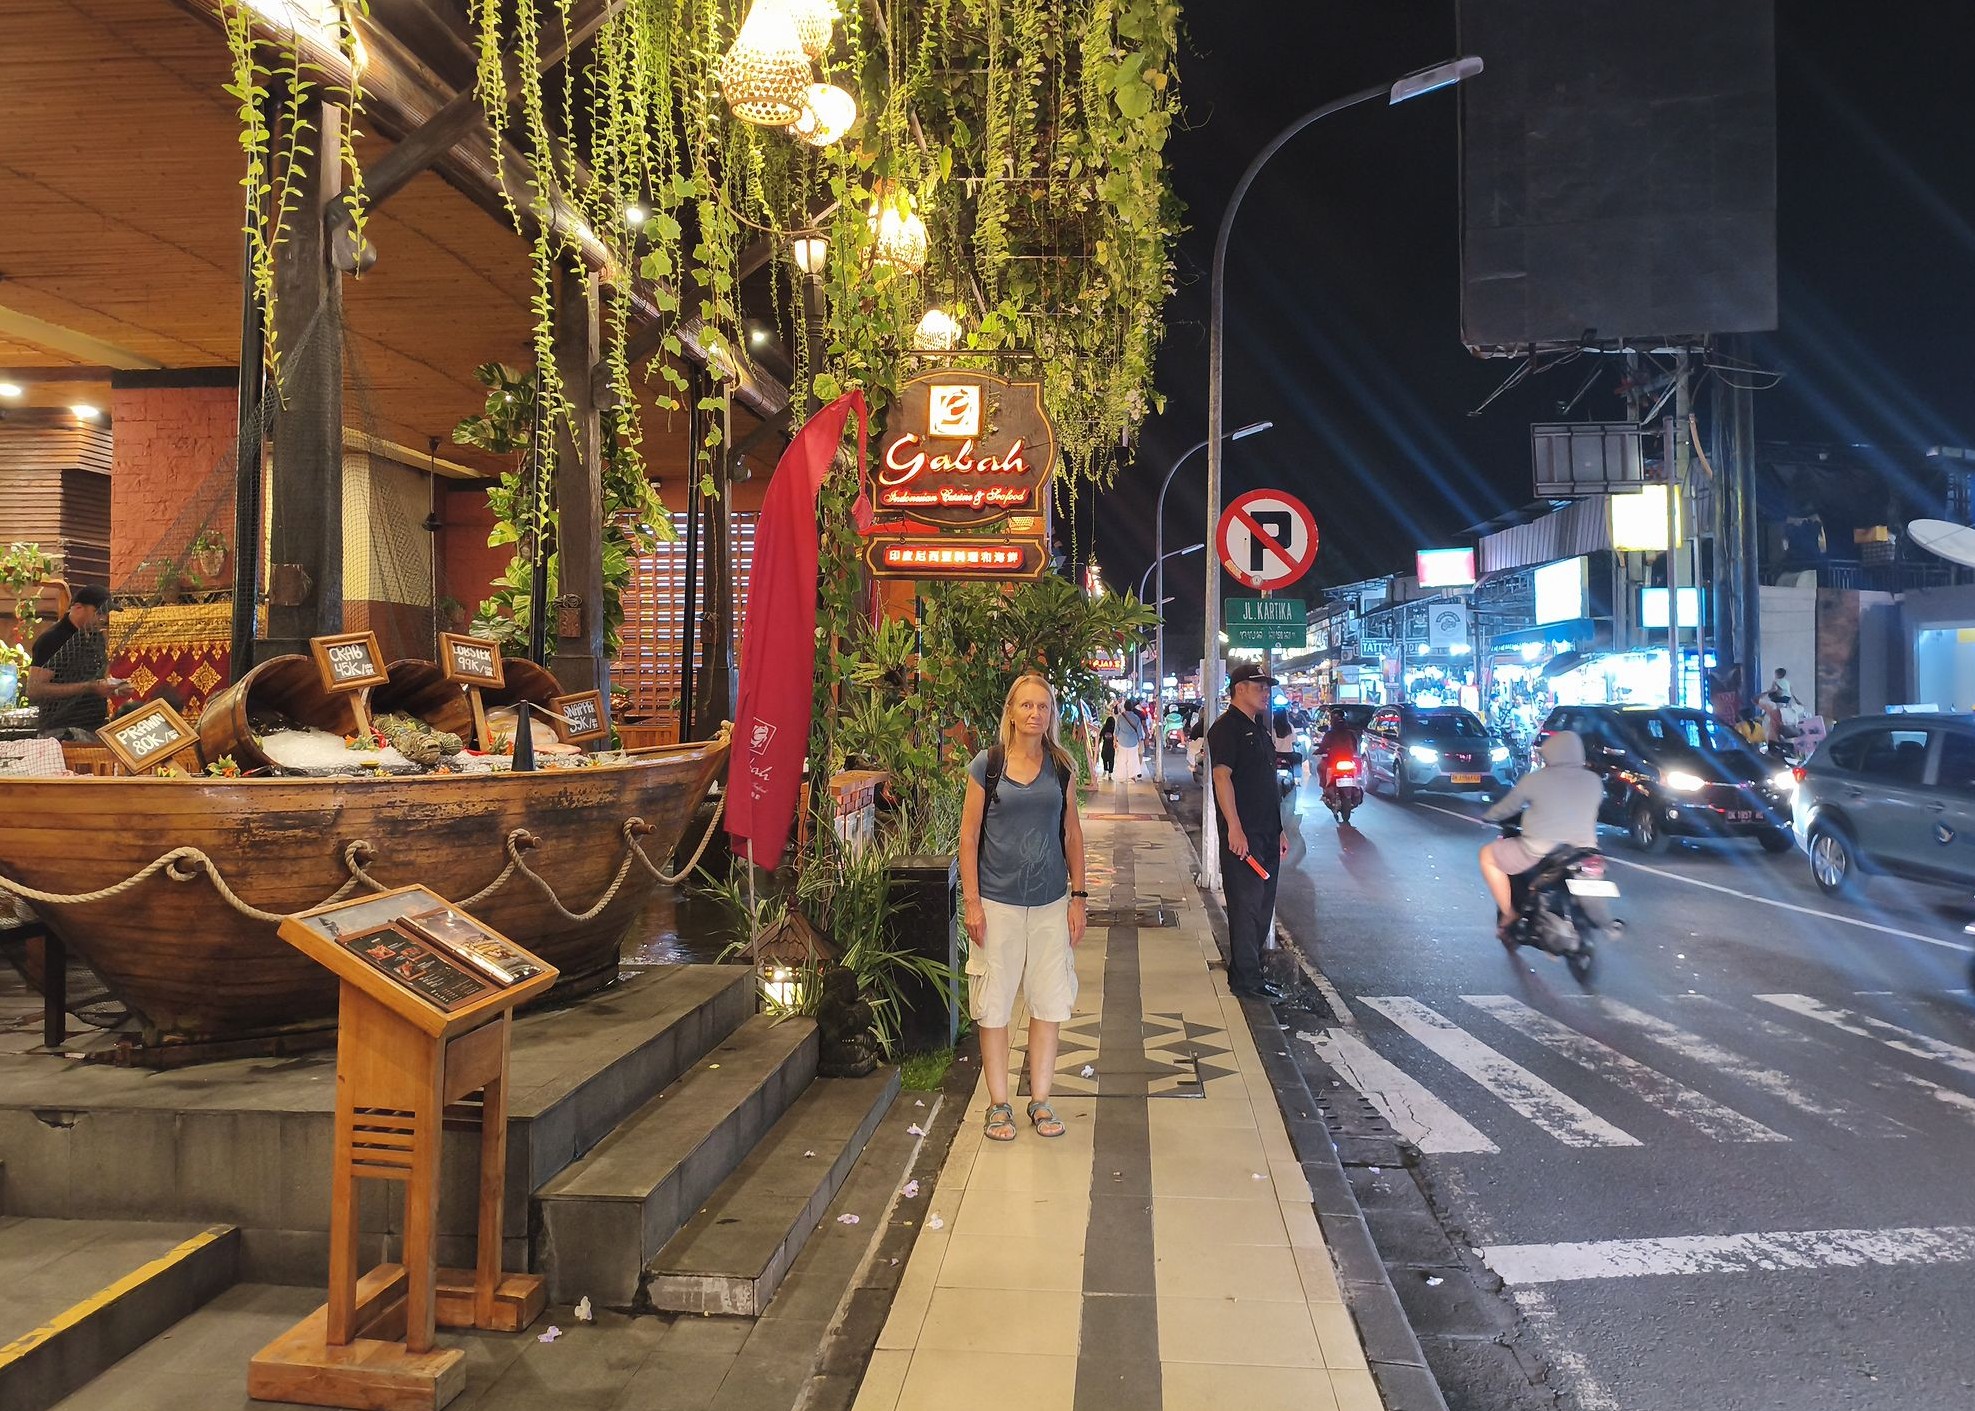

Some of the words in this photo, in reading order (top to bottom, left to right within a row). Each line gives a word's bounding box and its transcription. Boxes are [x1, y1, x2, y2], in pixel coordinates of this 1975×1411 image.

[878, 433, 1030, 485] Gabah
[986, 488, 1025, 505] Seafood
[328, 644, 363, 662] CRAB
[115, 712, 166, 745] PRAWN
